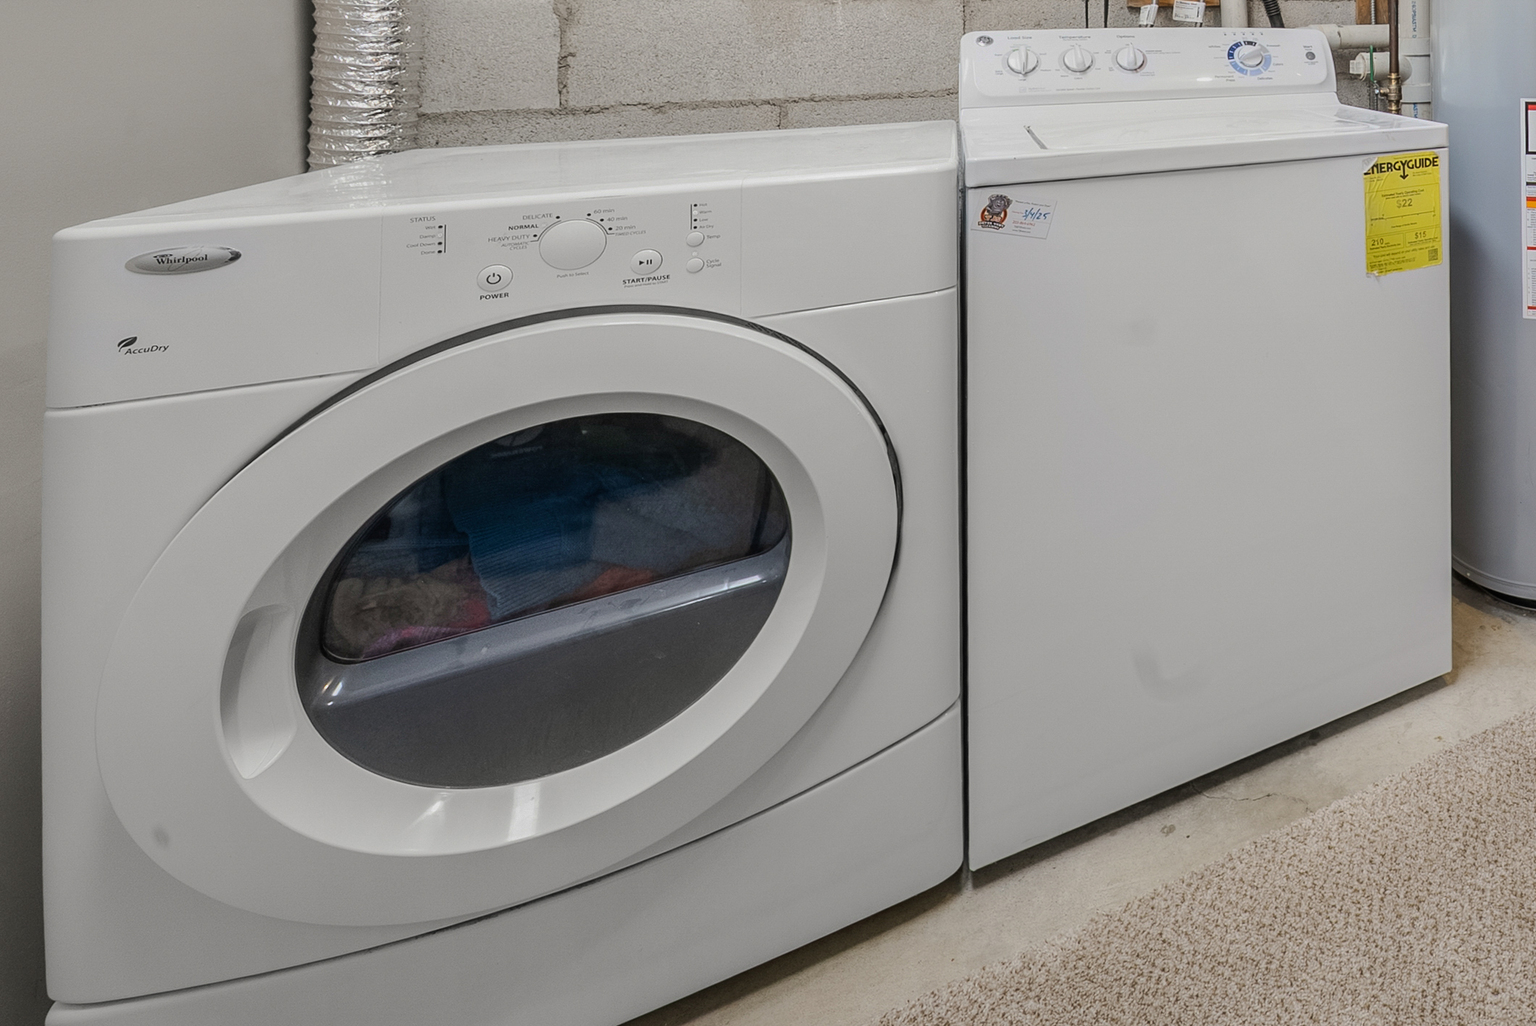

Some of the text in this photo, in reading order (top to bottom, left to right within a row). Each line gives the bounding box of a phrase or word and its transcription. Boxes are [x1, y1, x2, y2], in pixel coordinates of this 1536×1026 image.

[409, 216, 436, 224] STATUS
[522, 213, 553, 221] DELICATE
[155, 253, 208, 266] Whirlpool
[622, 274, 671, 285] START/PAUSE
[479, 292, 510, 301] POWER
[124, 344, 170, 356] AccuDry
